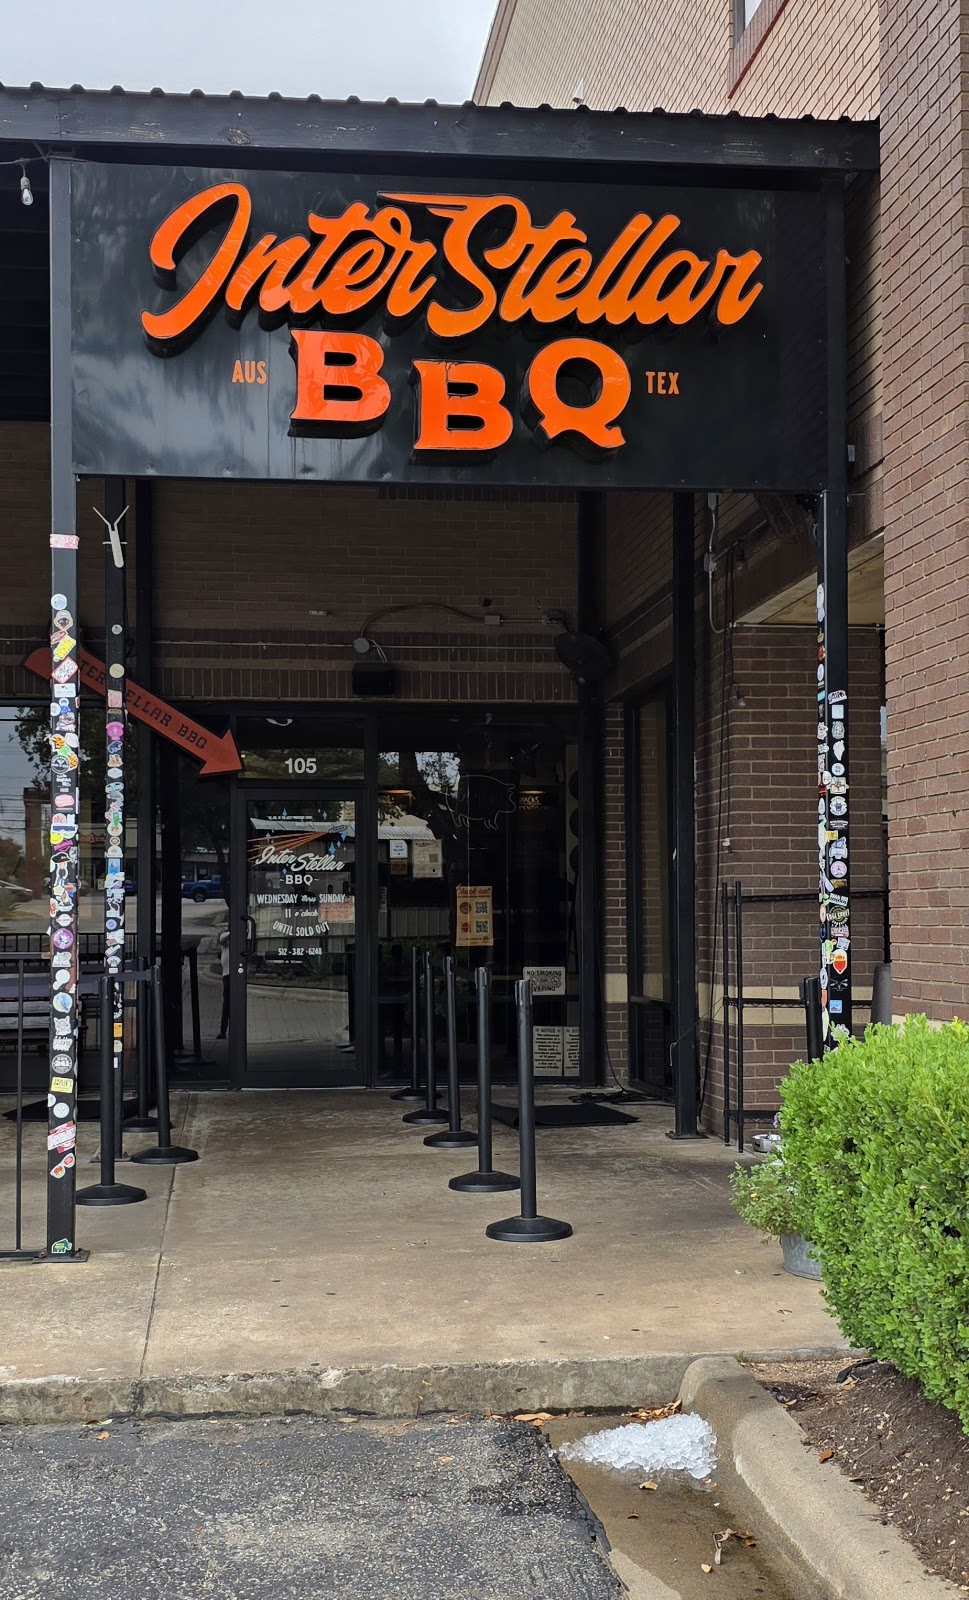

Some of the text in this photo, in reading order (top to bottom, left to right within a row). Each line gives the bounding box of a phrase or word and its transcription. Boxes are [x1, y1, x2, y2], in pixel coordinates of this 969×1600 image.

[232, 359, 267, 383] AUS
[290, 329, 631, 450] BBQ
[646, 371, 680, 395] TEX
[177, 723, 207, 750] BBQ
[284, 757, 317, 774] 105
[285, 874, 314, 886] BBQ
[256, 893, 299, 905] WEDNESDAY
[318, 893, 346, 904] SUNDAY
[284, 908, 292, 919] 11
[272, 920, 331, 937] UNTIL SOLD OUT
